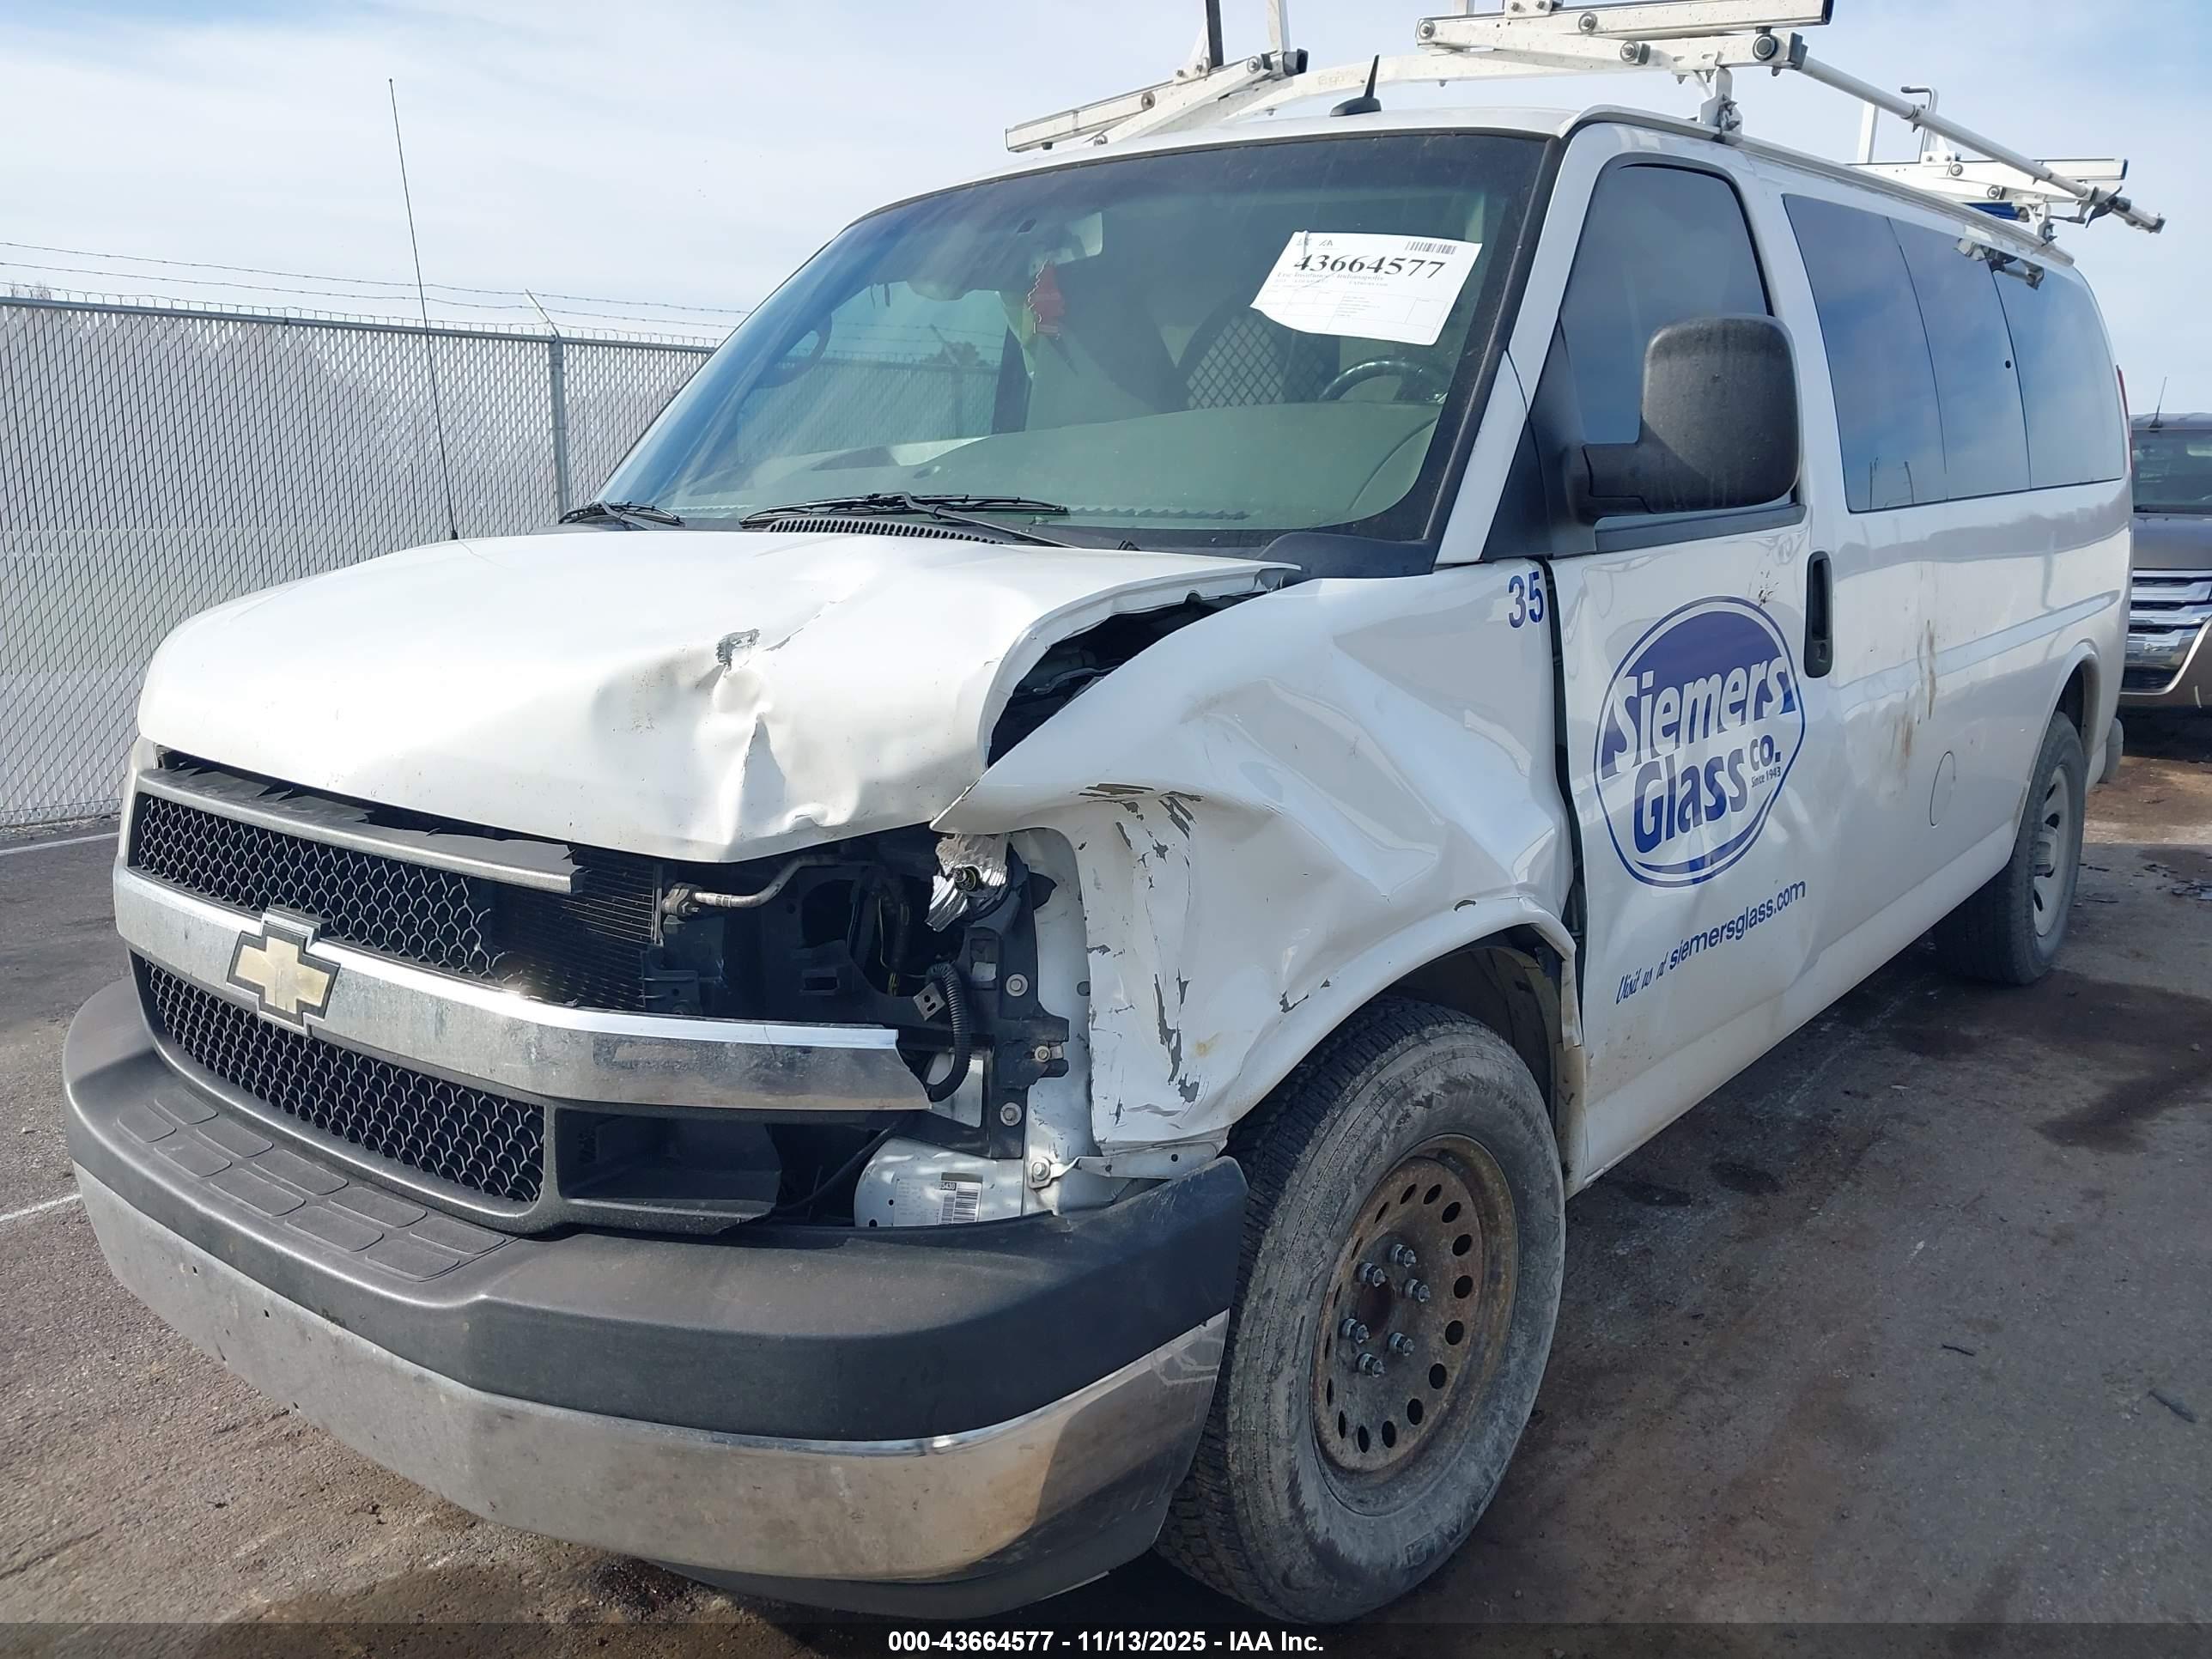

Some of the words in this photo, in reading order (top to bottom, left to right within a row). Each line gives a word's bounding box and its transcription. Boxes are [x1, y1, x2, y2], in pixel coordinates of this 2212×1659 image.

[1294, 254, 1447, 279] 43664577
[1509, 571, 1544, 628] 35
[1609, 656, 1790, 775] Siemers
[1634, 748, 1749, 854] Glass
[1616, 968, 1642, 1005] Visit
[1669, 880, 1806, 969] siemersglass.com
